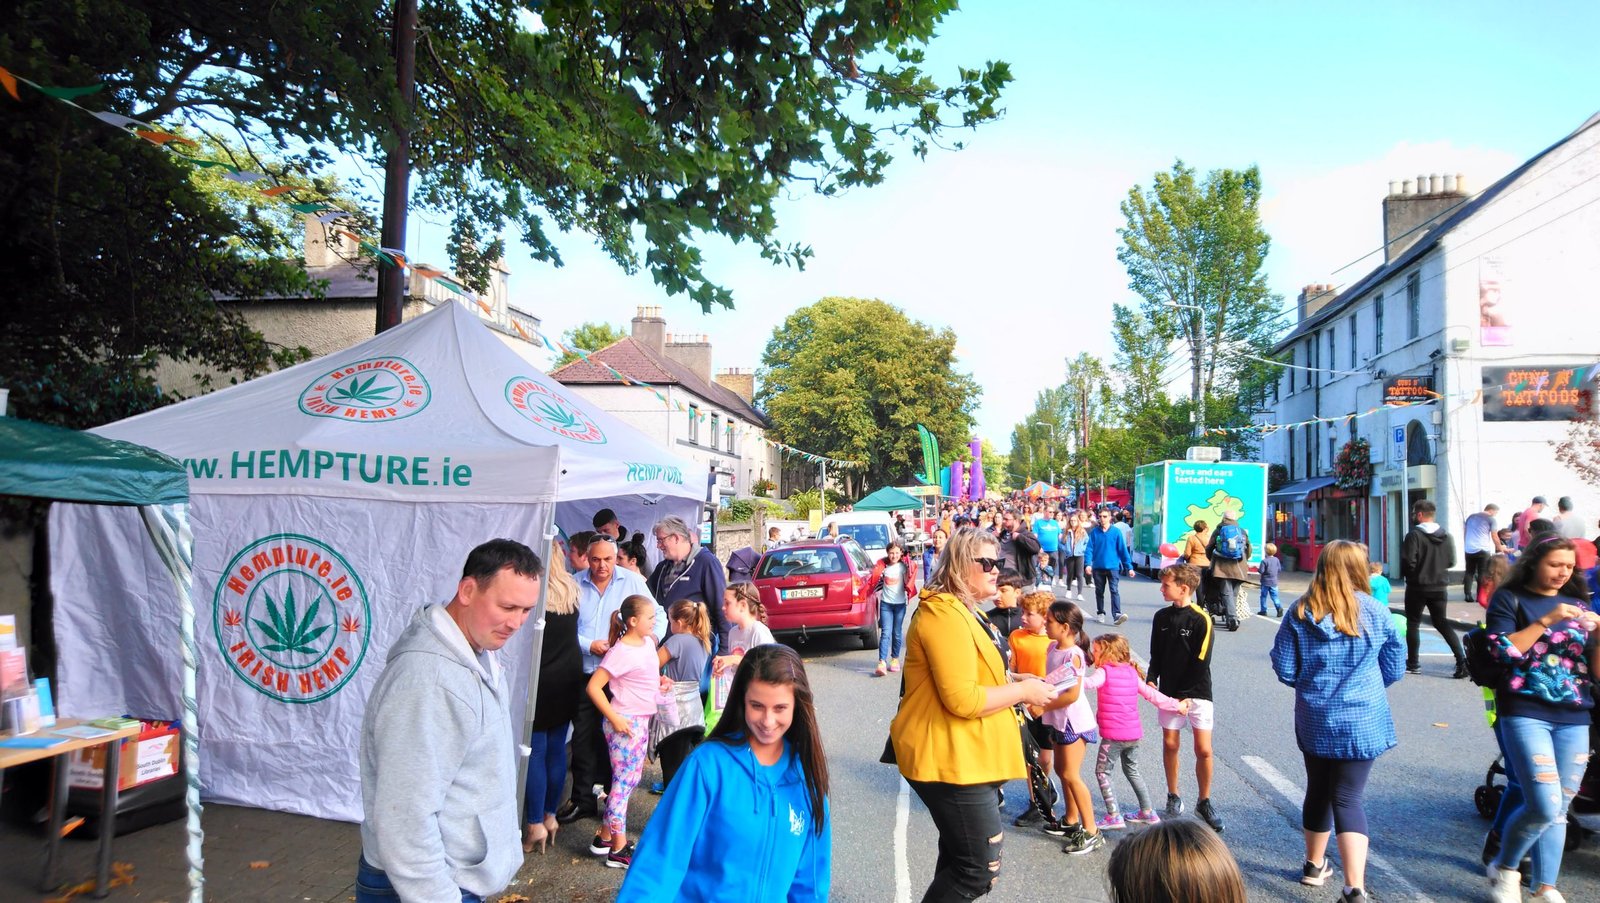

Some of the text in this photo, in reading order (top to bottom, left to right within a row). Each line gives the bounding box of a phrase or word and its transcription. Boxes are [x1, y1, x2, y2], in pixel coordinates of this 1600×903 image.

[1388, 386, 1428, 396] TATTOOS
[1502, 388, 1580, 407] TATTOOS
[344, 407, 398, 419] HEMP
[1174, 467, 1195, 476] Eyes
[1175, 476, 1225, 485] tested here
[227, 544, 353, 602] Hempture.ie
[230, 640, 350, 694] IRISH HEMP
